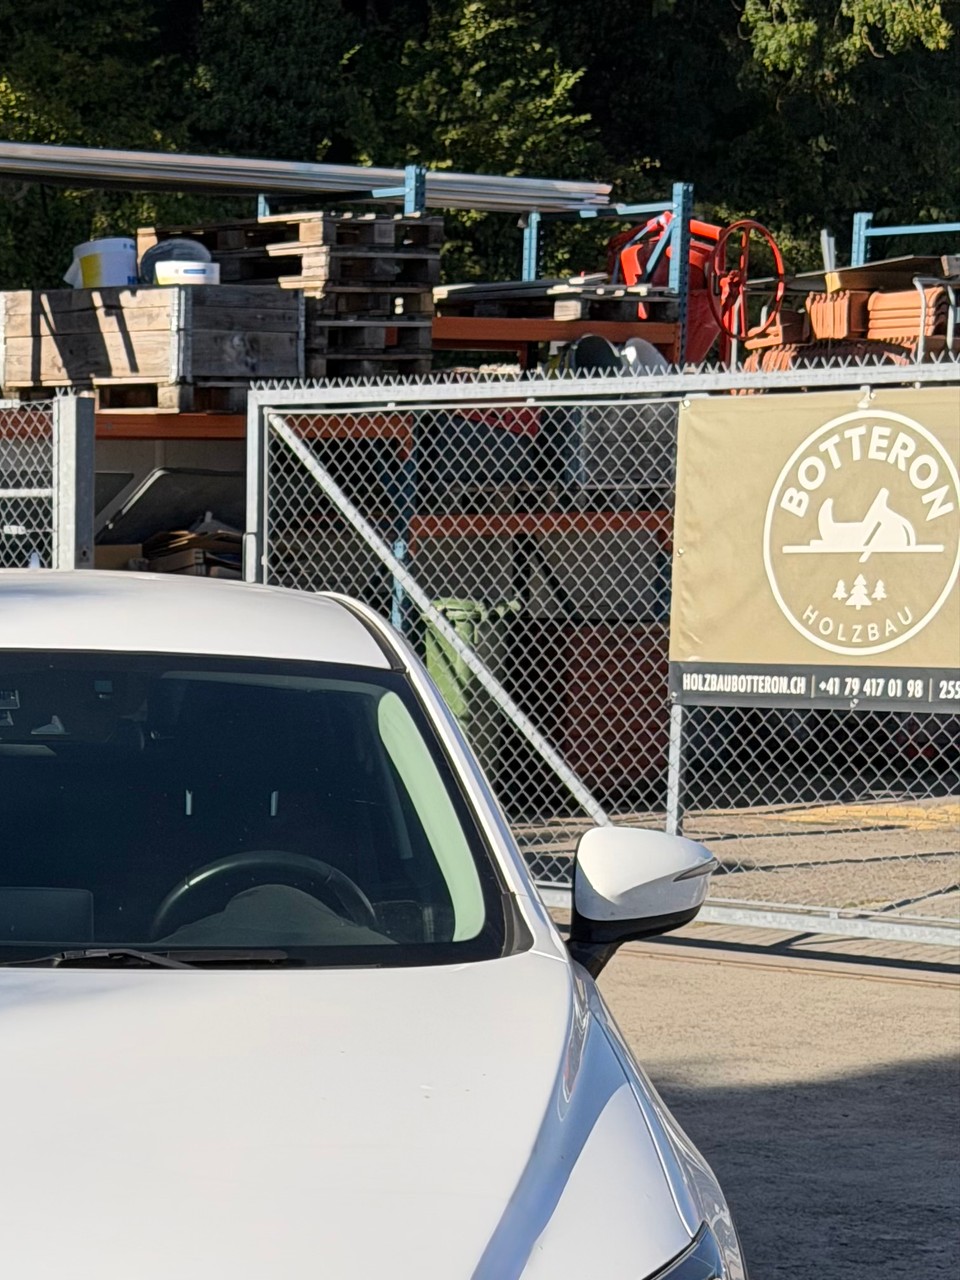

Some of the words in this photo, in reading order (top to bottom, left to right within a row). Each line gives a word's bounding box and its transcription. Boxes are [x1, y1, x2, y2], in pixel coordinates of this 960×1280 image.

[780, 425, 954, 521] BOTTERON
[802, 604, 914, 642] HOLZBAU
[682, 673, 807, 694] HOLZBAUBOTTERON.CH
[819, 677, 840, 696] +41
[844, 677, 860, 696] 79
[863, 678, 885, 697] 417
[887, 678, 902, 698] 01
[906, 679, 923, 698] 98
